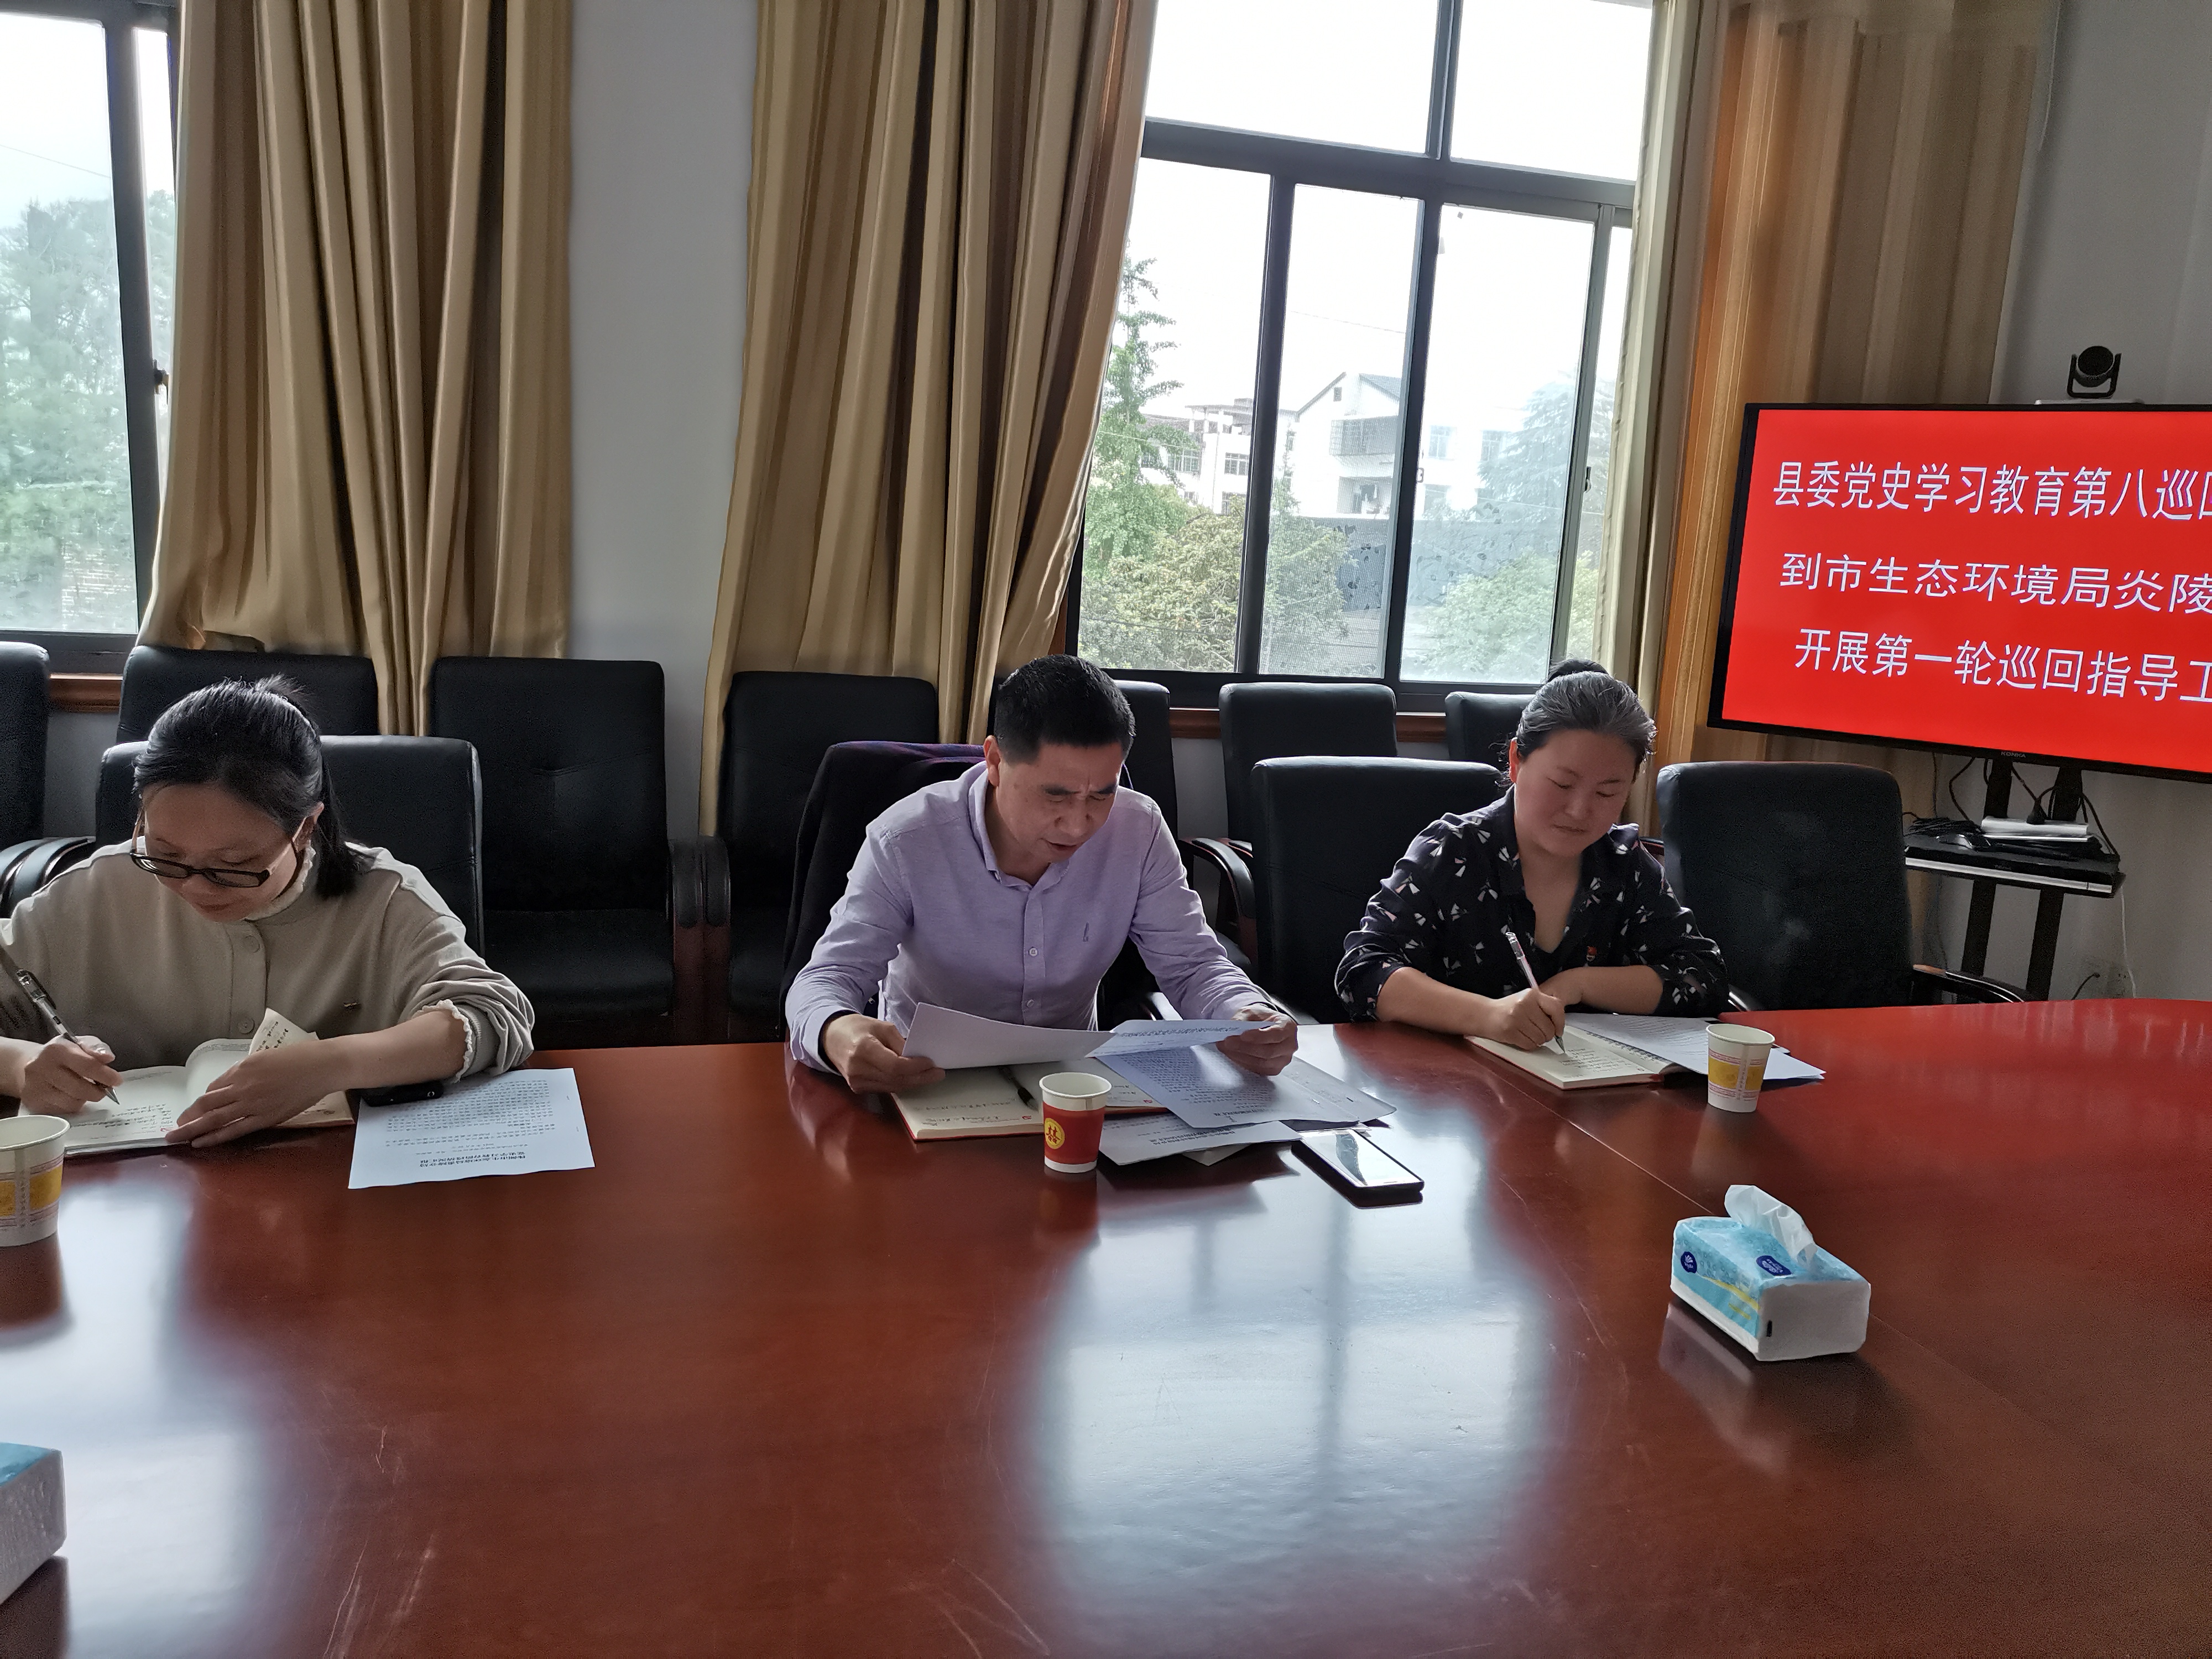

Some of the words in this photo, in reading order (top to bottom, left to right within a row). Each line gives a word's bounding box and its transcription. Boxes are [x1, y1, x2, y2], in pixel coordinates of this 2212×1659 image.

[1780, 552, 2212, 614] 到市生态环境局炎陵
[1794, 628, 2212, 703] 开展第一轮巡回指导工
